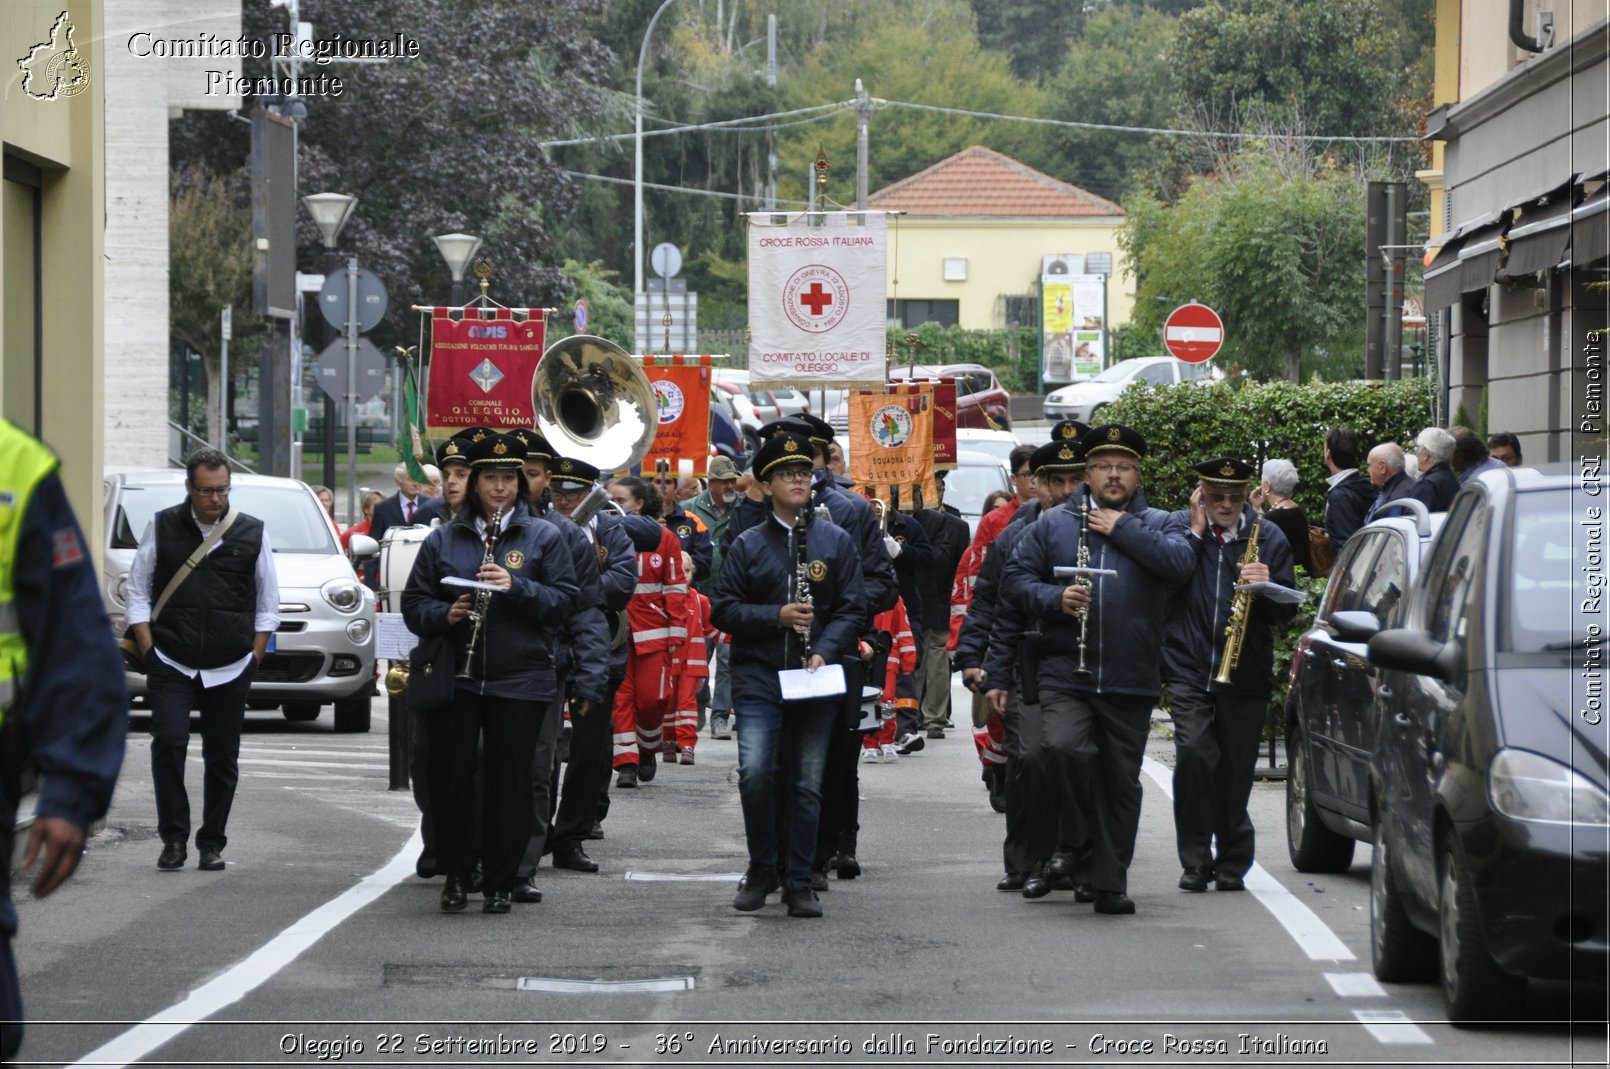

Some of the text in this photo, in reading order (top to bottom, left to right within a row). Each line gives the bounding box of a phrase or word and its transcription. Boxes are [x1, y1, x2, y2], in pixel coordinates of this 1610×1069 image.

[760, 237, 874, 247] CROCE ROSSA ITALIANA
[787, 285, 811, 327] CONVENZIONE
[801, 268, 830, 279] GINEVRA
[831, 275, 839, 284] 22
[468, 326, 507, 338] AVIS
[763, 352, 870, 363] COMITATO LOCALE DI
[795, 362, 838, 373] OLEGGIO
[468, 399, 503, 407] COMUNALE
[452, 406, 520, 416] OLEGGIO
[872, 456, 904, 465] SQUADRA
[867, 470, 920, 480] OLEGGIO
